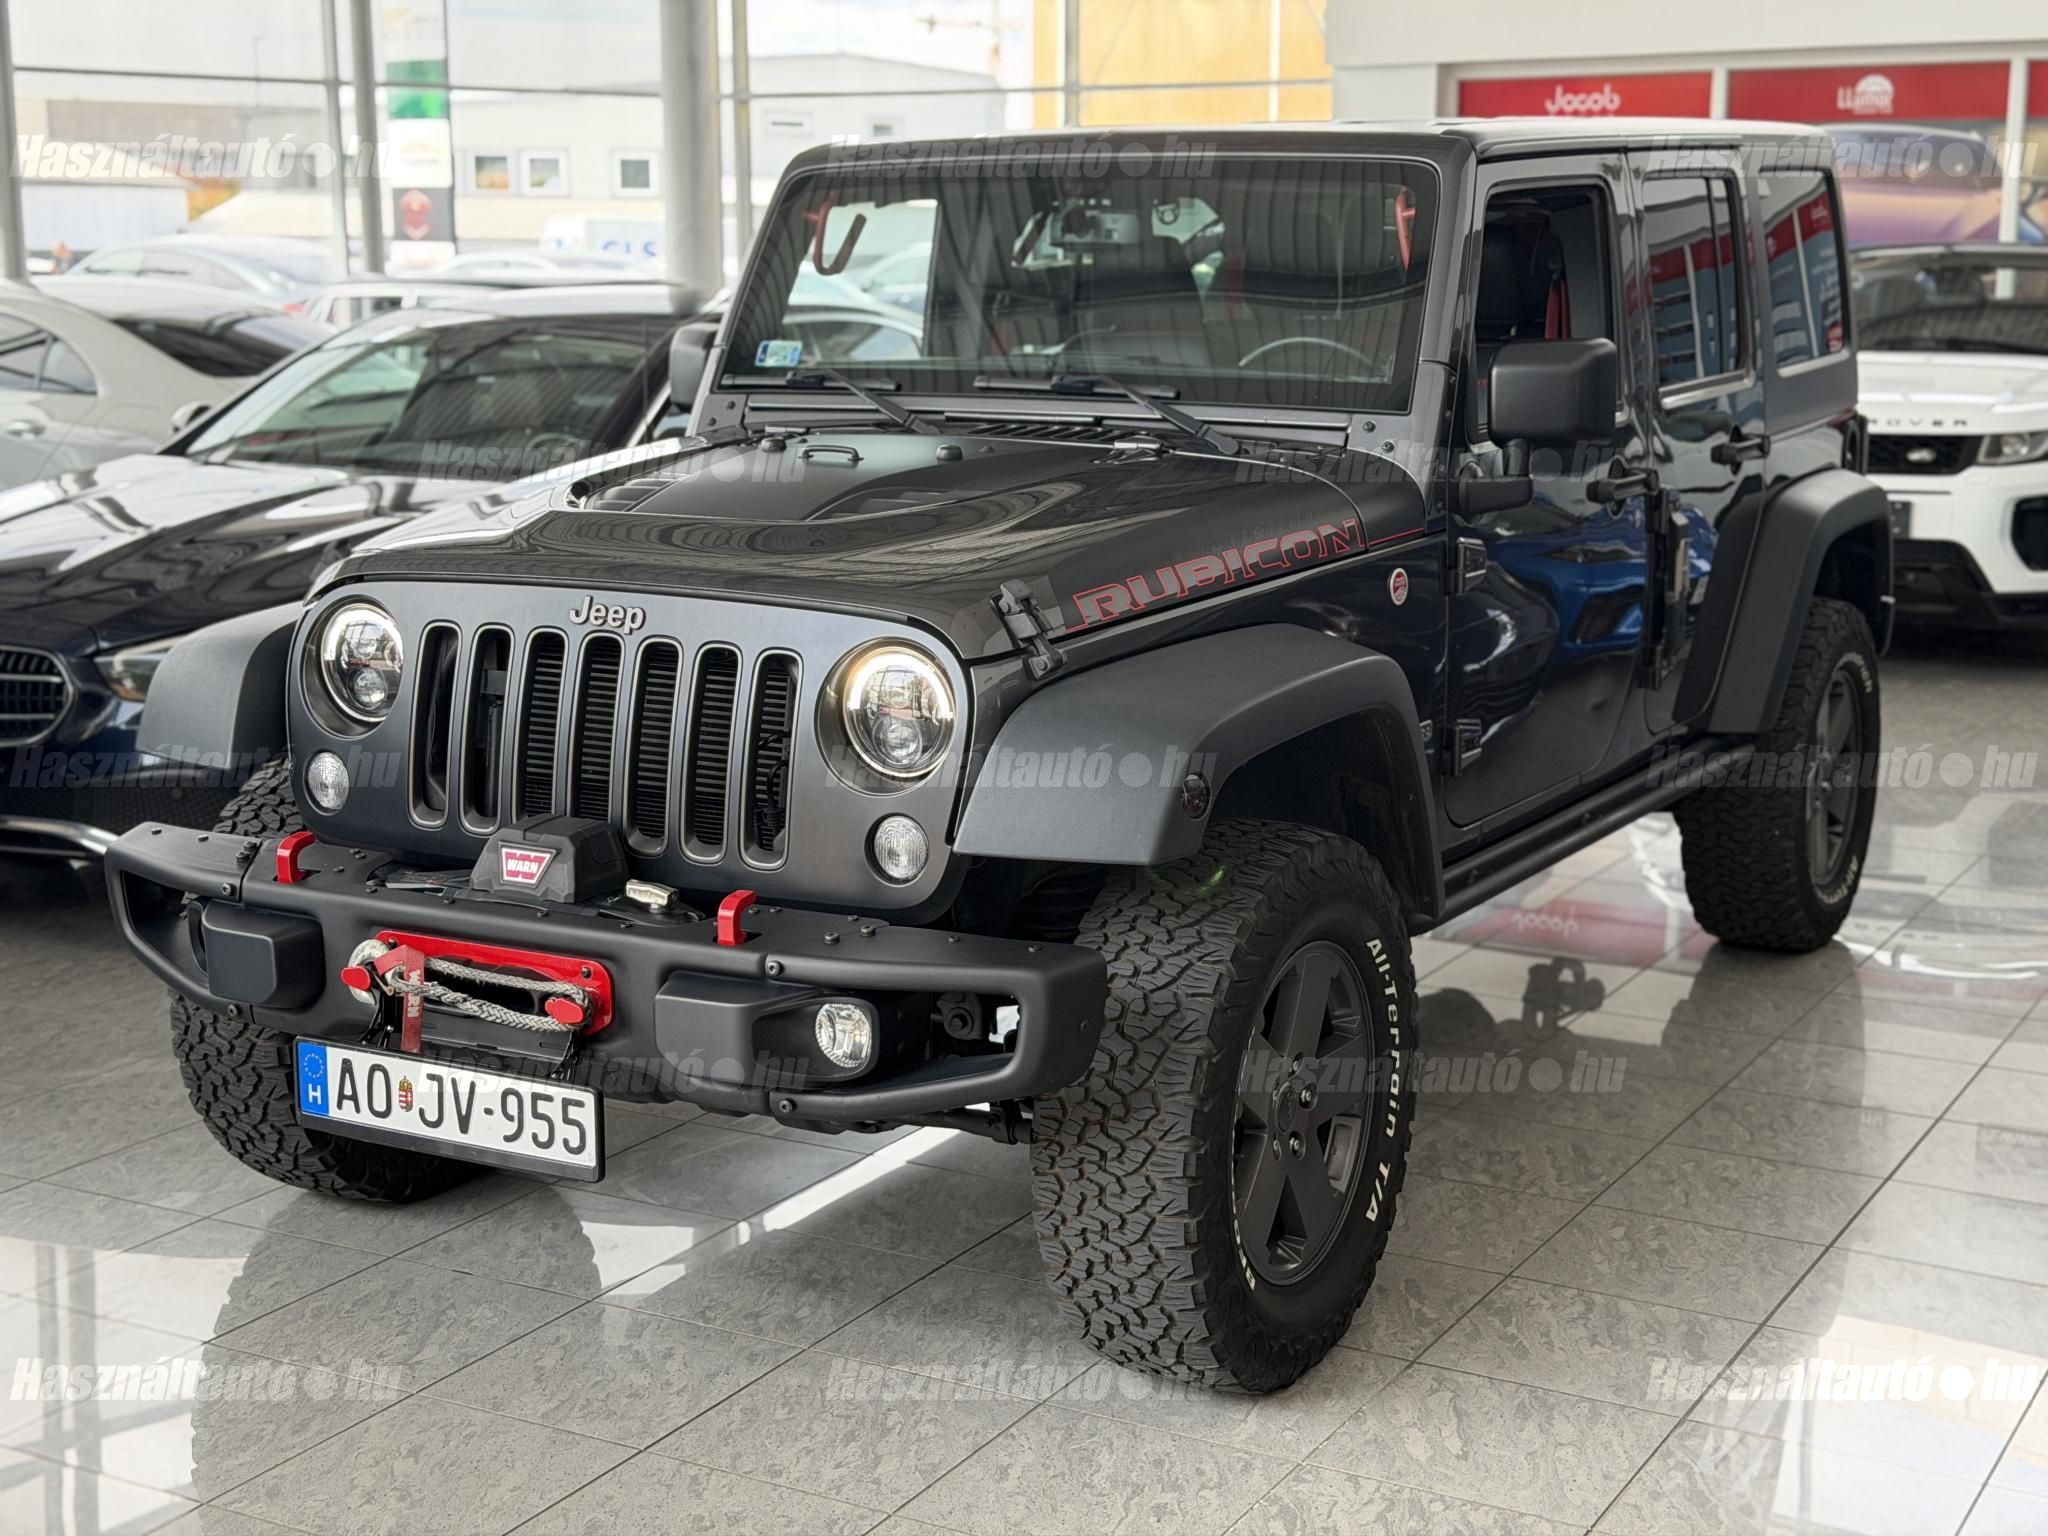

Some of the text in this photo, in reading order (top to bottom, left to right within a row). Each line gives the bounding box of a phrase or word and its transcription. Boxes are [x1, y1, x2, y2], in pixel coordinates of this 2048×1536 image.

[1072, 517, 1367, 624] RUBICON
[569, 594, 646, 635] Jeep
[507, 859, 539, 874] WARN
[308, 1083, 322, 1105] H
[336, 1057, 587, 1155] AO JV-955
[1365, 938, 1399, 1222] All-Terrain T/A
